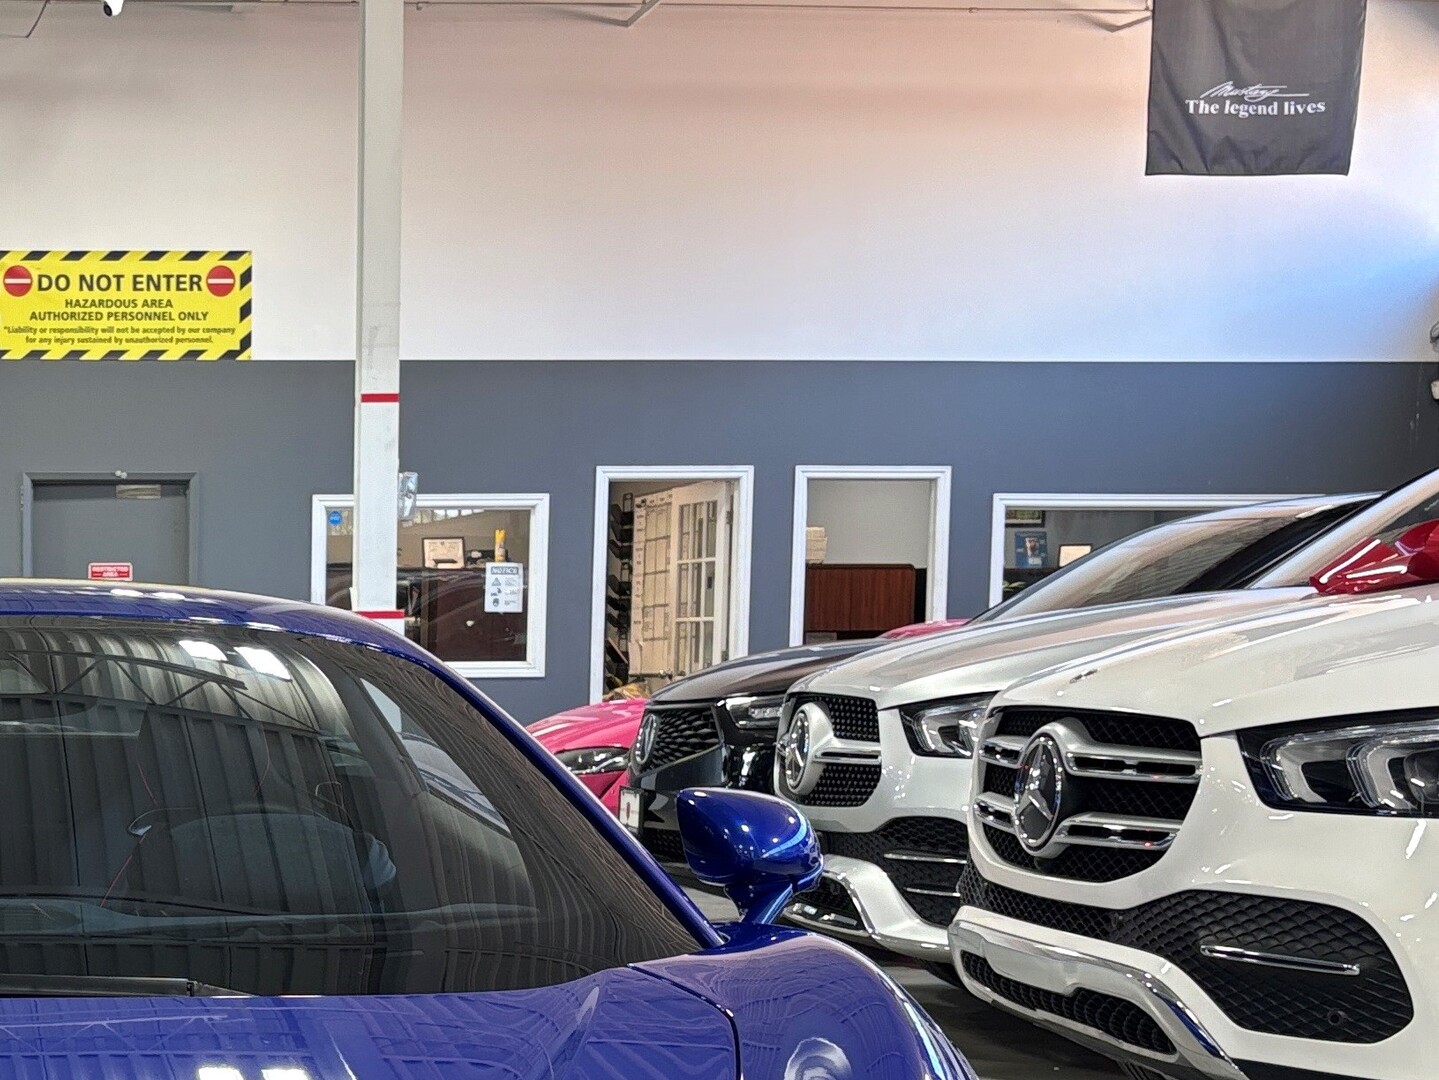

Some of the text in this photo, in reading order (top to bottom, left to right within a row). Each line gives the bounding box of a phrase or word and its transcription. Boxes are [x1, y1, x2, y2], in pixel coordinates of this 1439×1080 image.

[1185, 99, 1326, 119] The legend lives
[37, 274, 203, 292] DO NOT ENTER
[65, 299, 173, 309] HAZARDOUS AREA
[29, 311, 209, 321] AUTHORIZED PERSONNEL ONLY
[49, 326, 99, 335] responsibility
[101, 326, 115, 334] will
[116, 326, 129, 334] not
[131, 326, 140, 334] be
[142, 326, 175, 335] accepted
[177, 326, 186, 335] by
[202, 327, 236, 335] company
[25, 335, 36, 343] for
[38, 337, 52, 345] any
[54, 336, 75, 345] injury
[114, 336, 123, 345] by
